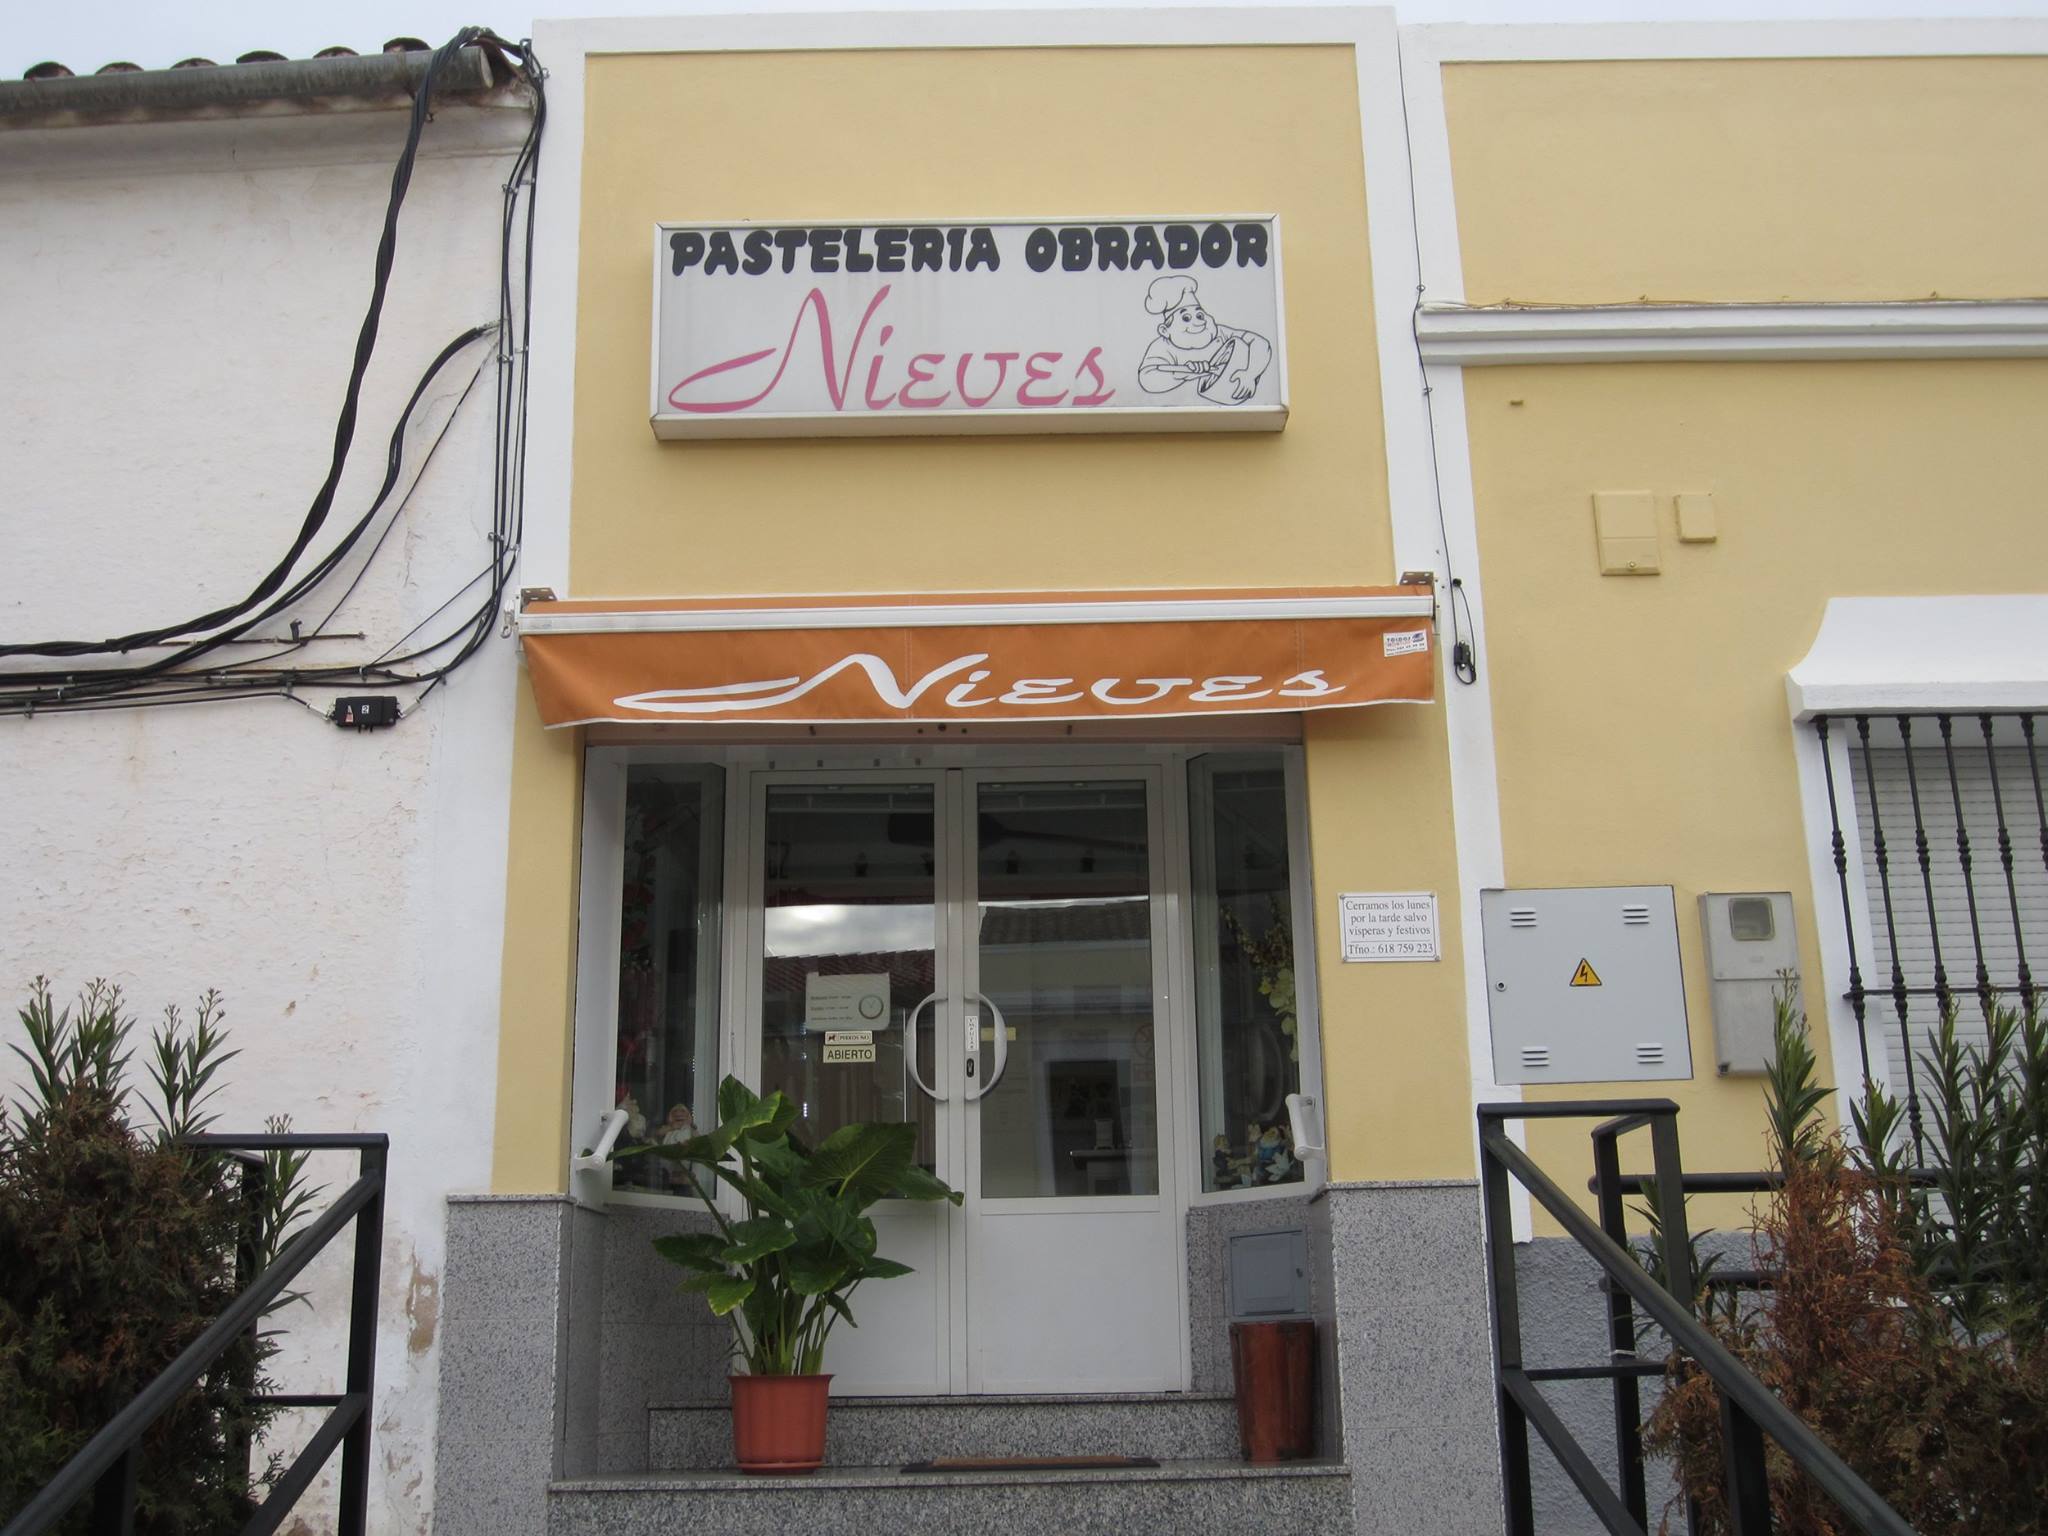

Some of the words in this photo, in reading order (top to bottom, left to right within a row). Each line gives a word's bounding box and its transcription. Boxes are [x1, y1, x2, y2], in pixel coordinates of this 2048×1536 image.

[670, 228, 1000, 276] PASTELERIA
[1025, 223, 1268, 271] OBRADOR
[668, 284, 1116, 413] Nieves
[613, 654, 1346, 713] Nieves
[1345, 900, 1389, 911] Cerramos
[1391, 900, 1404, 910] los
[1407, 900, 1430, 910] lunes
[1350, 915, 1365, 926] por
[1368, 913, 1377, 922] la
[1379, 913, 1401, 922] tarde
[1404, 913, 1427, 922] salvo
[1387, 927, 1393, 937] y
[1396, 925, 1431, 935] festivos
[1378, 944, 1395, 954] 618
[1398, 943, 1414, 953] 759
[1417, 943, 1433, 953] 223
[827, 1049, 873, 1060] ABIERTO
